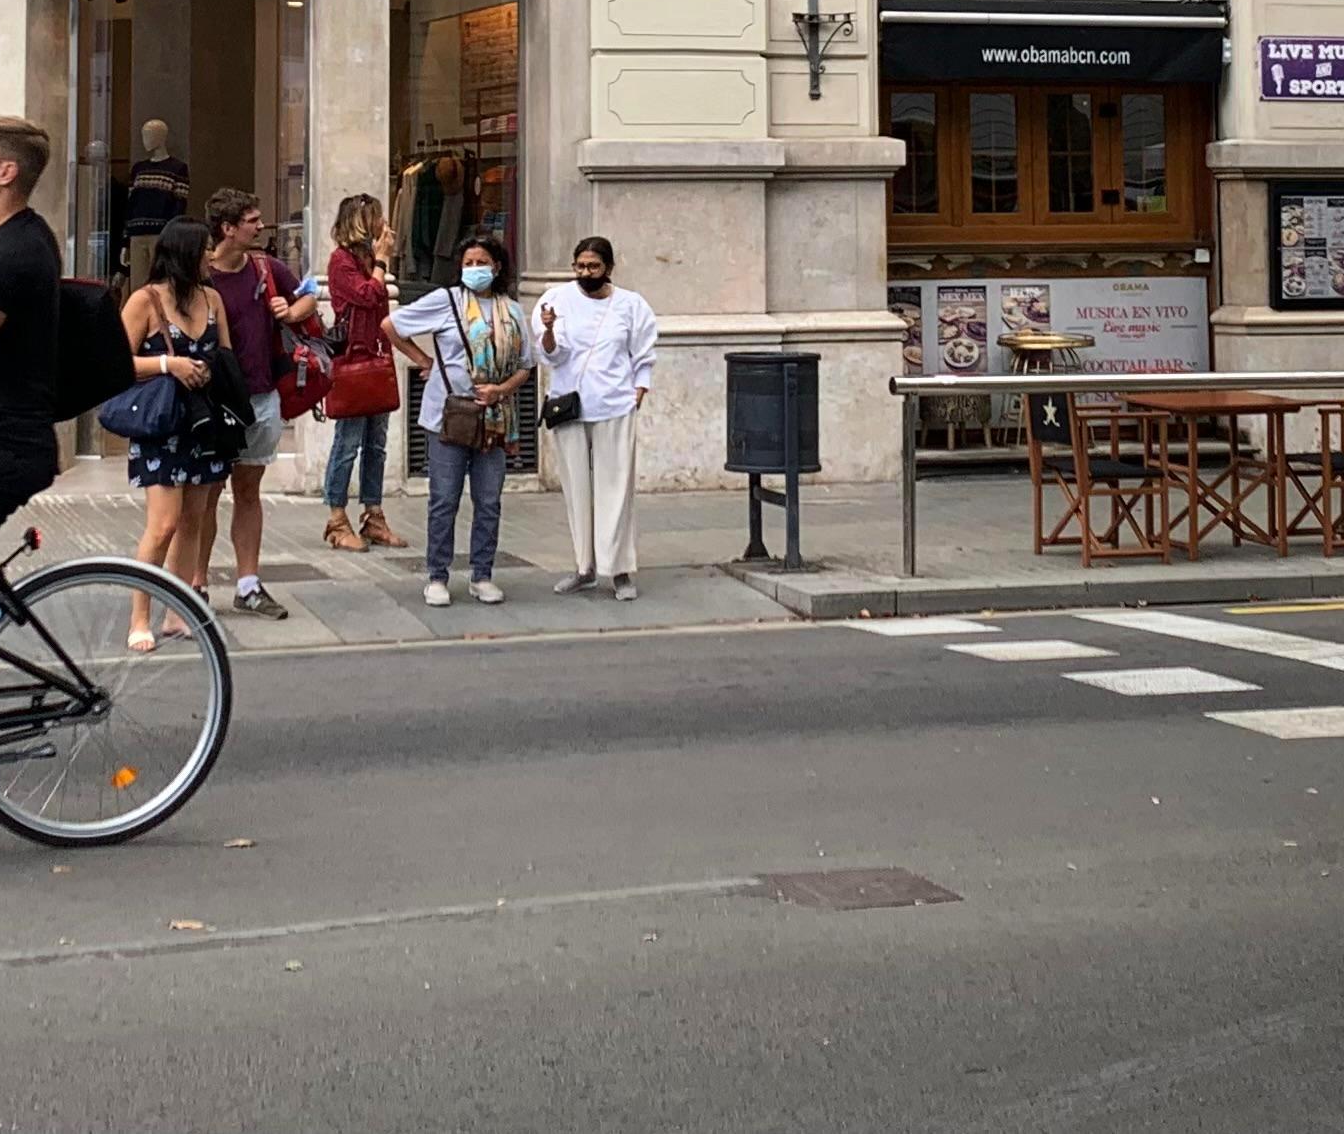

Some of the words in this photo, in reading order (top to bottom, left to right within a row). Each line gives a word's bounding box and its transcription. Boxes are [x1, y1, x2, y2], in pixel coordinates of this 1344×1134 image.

[981, 44, 1131, 65] www.obamabcn.com
[1267, 43, 1314, 60] LIVE
[1112, 283, 1150, 292] OBAMA
[1076, 307, 1129, 320] MUSICA
[1132, 306, 1151, 319] EN
[1155, 306, 1189, 319] VIVO
[1154, 358, 1185, 372] BAR
